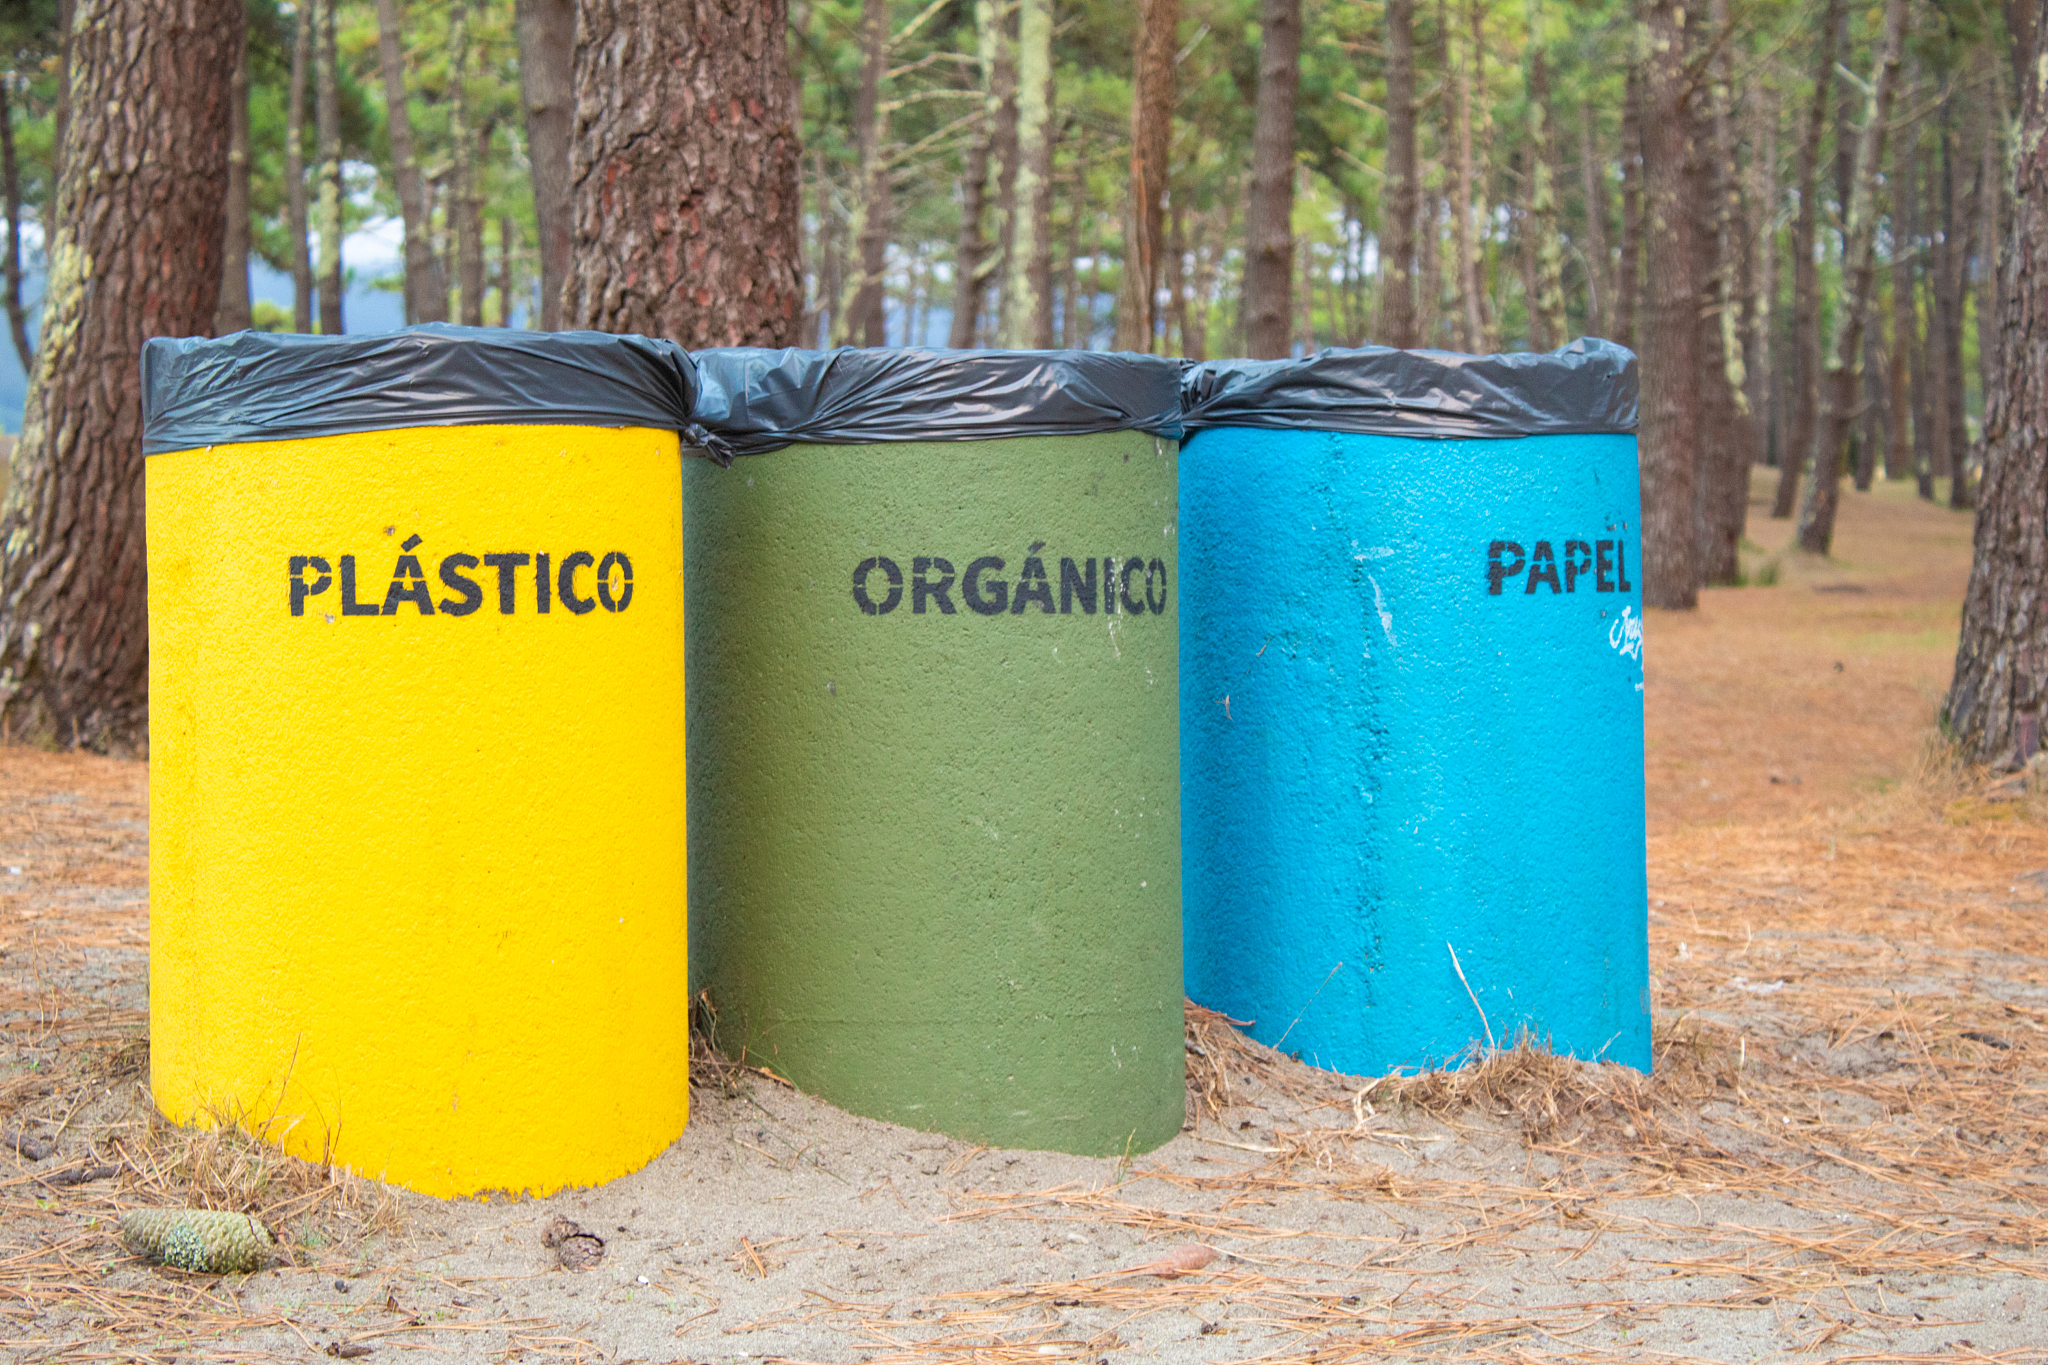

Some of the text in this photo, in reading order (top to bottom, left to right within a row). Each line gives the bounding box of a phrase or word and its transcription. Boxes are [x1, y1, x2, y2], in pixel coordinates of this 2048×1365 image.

[288, 533, 634, 617] PLÁSTICO
[852, 540, 1168, 616] ORGÁNICO
[1487, 539, 1632, 595] PAPEL
